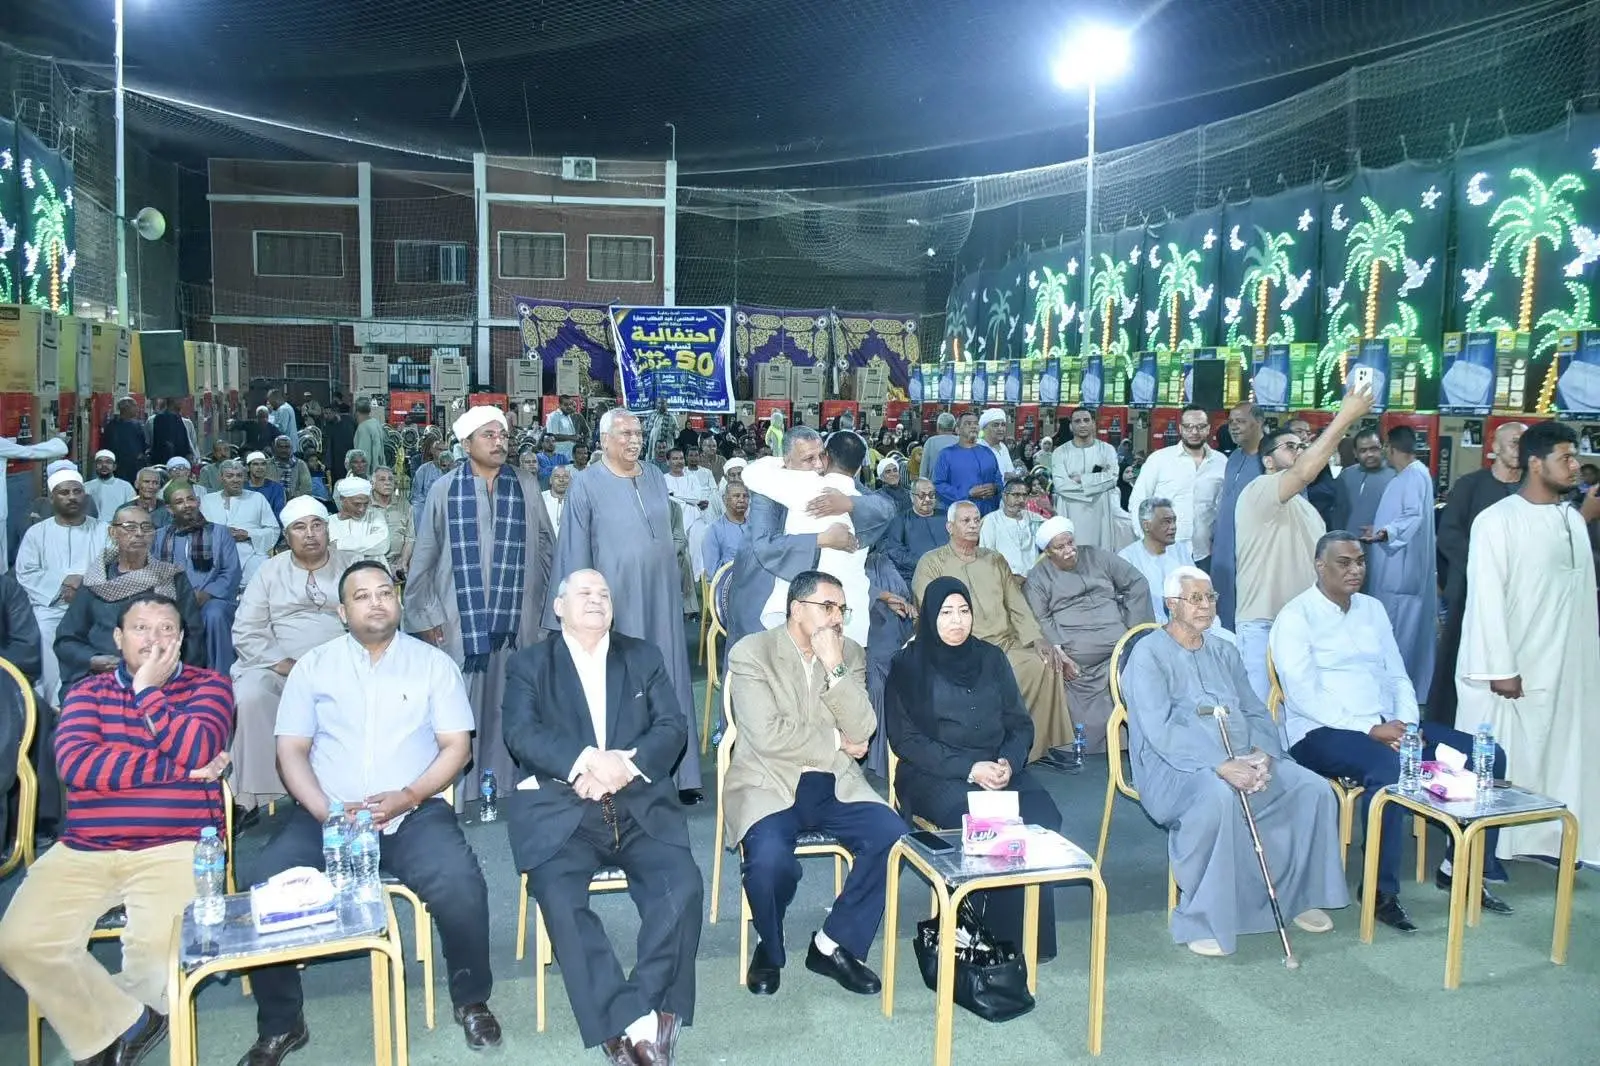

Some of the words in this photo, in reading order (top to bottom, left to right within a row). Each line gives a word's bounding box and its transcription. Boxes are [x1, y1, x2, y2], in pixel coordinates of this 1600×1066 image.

[632, 325, 716, 344] احتفالية
[633, 349, 665, 362] جهاز
[638, 359, 672, 374] عروس
[676, 350, 715, 377] 50
[704, 398, 725, 408] الرحمة
